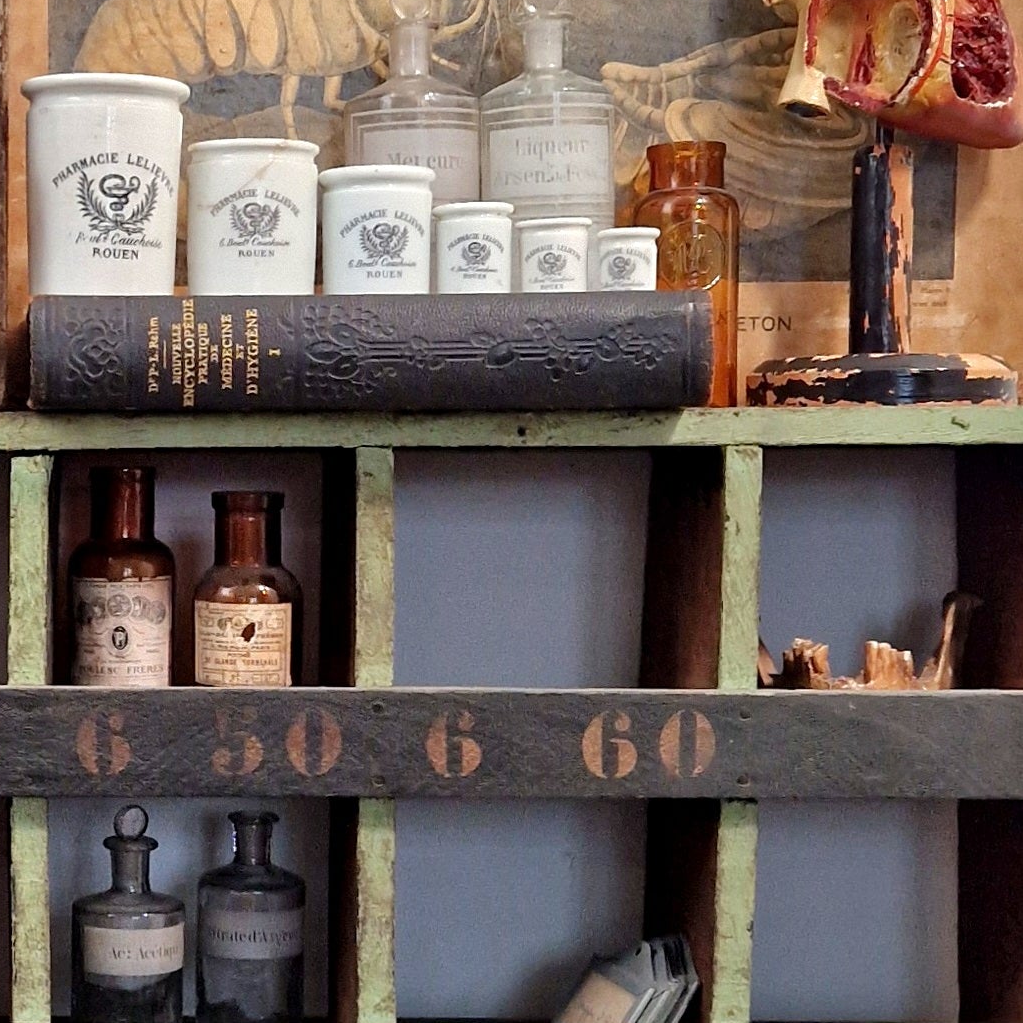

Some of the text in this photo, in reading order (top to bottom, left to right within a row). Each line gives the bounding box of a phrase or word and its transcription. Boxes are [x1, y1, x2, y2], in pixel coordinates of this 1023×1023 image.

[52, 153, 119, 188] PHARMACIE
[210, 189, 258, 217] PHARMACIE
[339, 209, 388, 238] PHARMACIE
[92, 247, 139, 260] ROUEN
[238, 249, 275, 258] ROUEN
[366, 270, 403, 279] ROUEN
[737, 316, 792, 331] ETON
[172, 322, 182, 385] NOUVELLE
[197, 322, 209, 385] PRATIQUE
[210, 344, 219, 364] DE
[235, 343, 245, 361] ET
[76, 711, 130, 776] 6
[212, 711, 343, 776] 50
[426, 715, 481, 776] 6
[581, 714, 714, 779] 60
